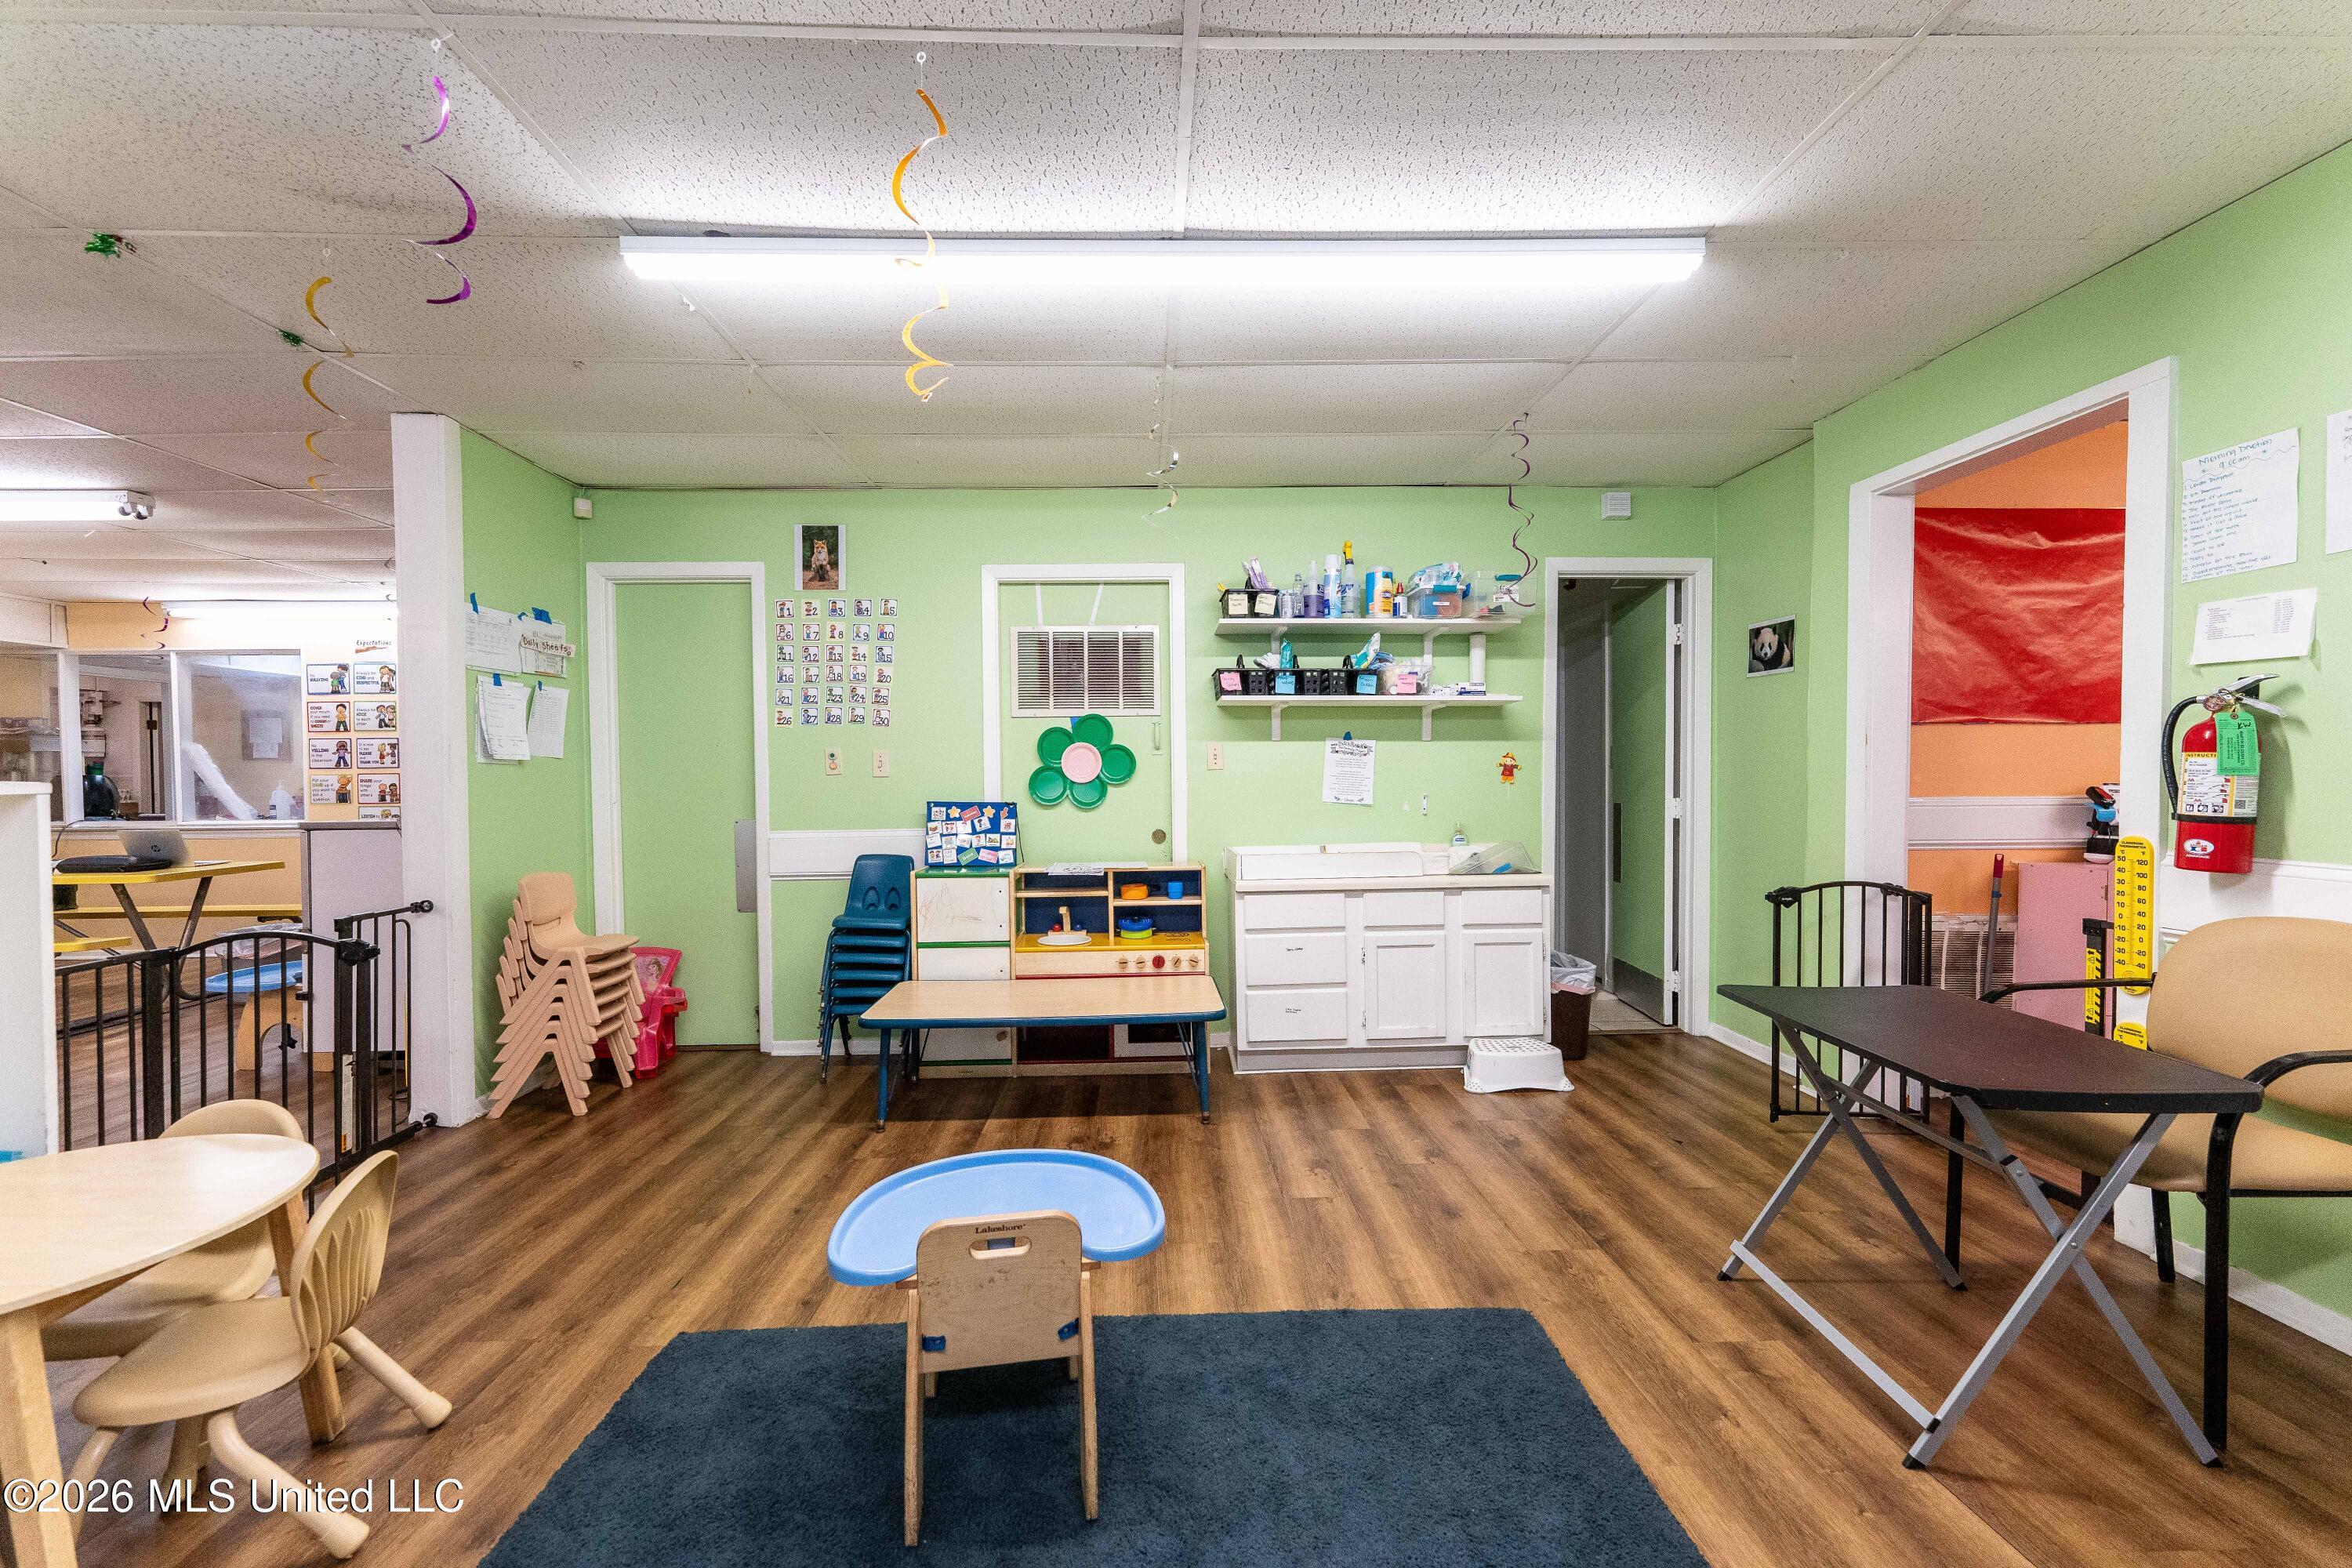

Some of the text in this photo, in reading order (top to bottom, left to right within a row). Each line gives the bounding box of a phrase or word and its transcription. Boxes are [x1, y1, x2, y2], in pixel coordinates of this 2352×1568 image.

[523, 637, 539, 649] Daily
[883, 654, 891, 662] 15
[856, 694, 865, 702] 24
[831, 714, 840, 723] 28
[855, 714, 864, 723] 29
[962, 852, 974, 861] Done
[975, 1225, 1023, 1234] Lakeshore
